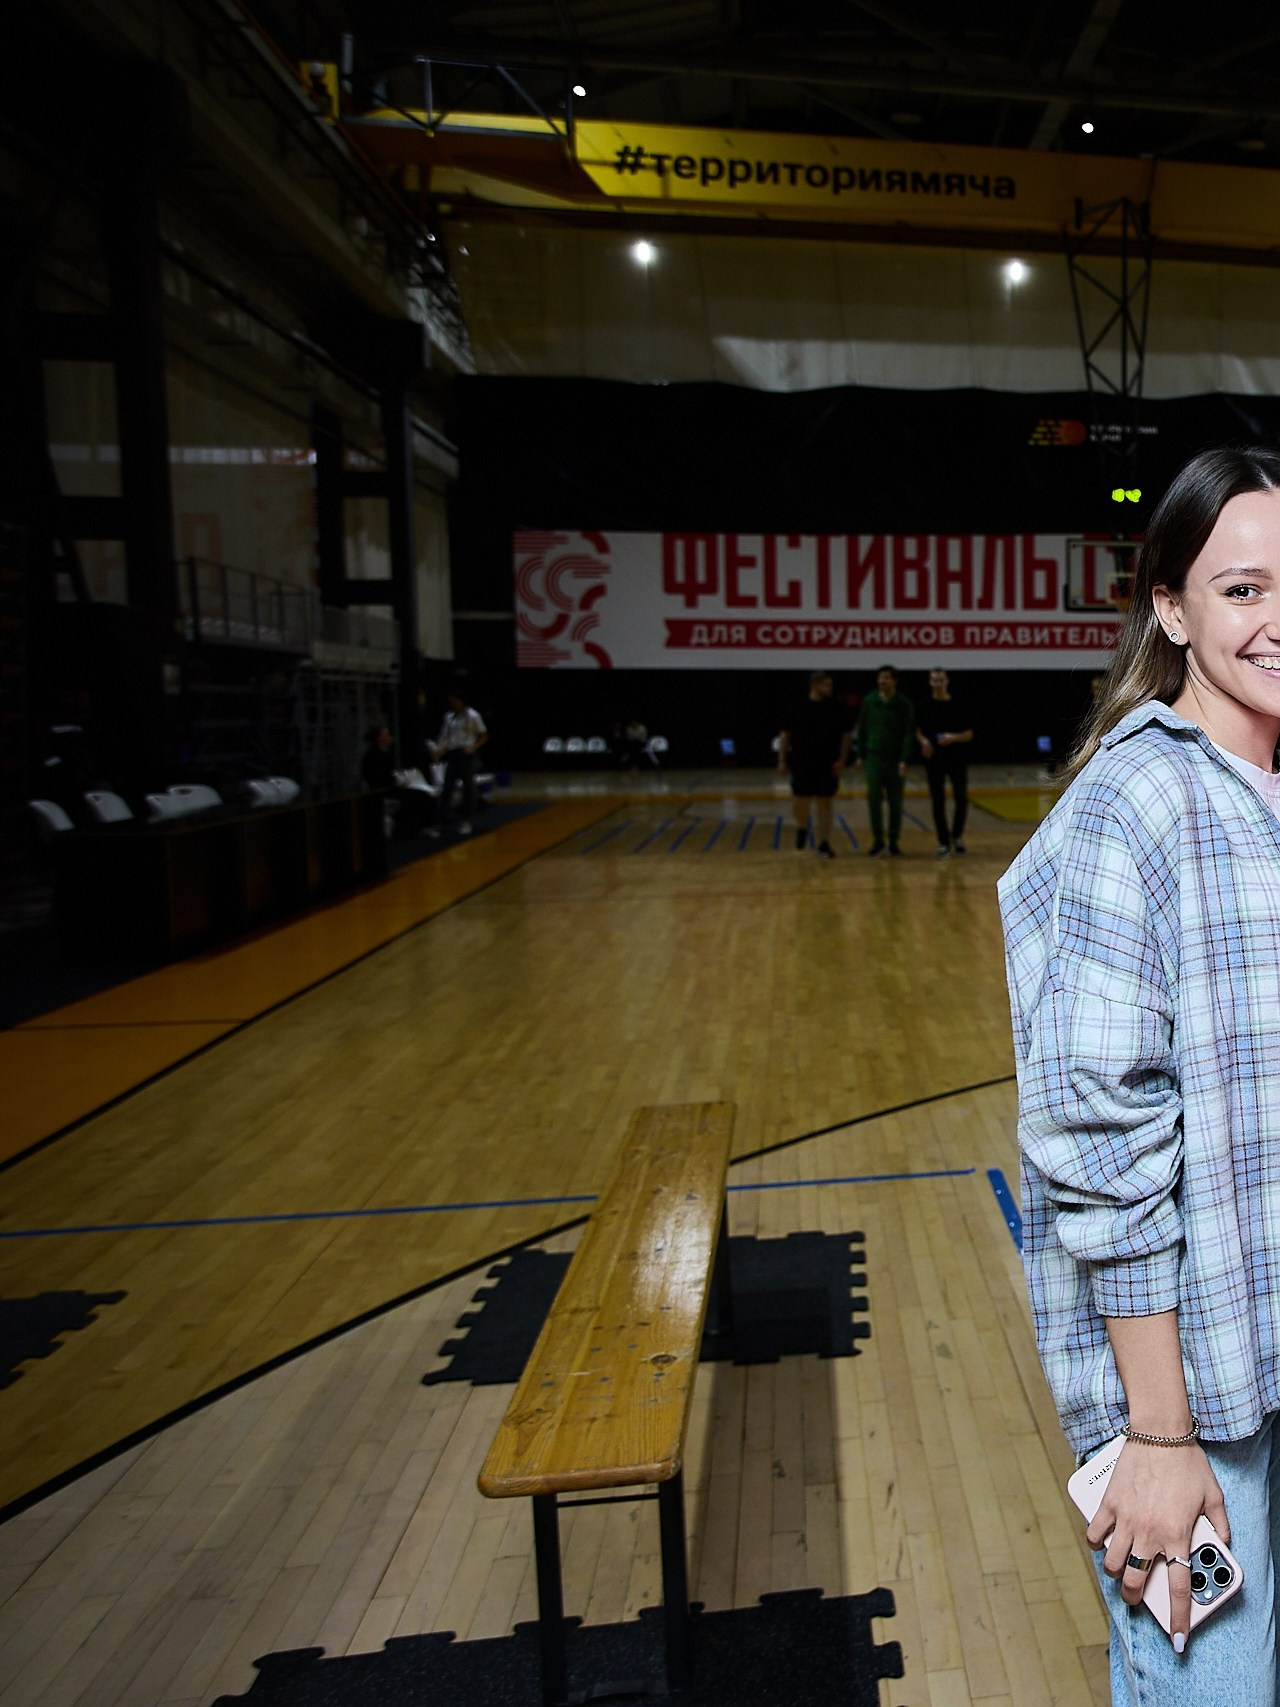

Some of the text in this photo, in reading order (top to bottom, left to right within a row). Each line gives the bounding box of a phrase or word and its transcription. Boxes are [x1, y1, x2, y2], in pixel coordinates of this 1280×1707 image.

[614, 145, 1018, 199] #территориямяча
[663, 531, 1057, 609] ФЕСТИВАЛЬ
[691, 624, 747, 648] ДЛЯ
[755, 624, 956, 649] СОТРУДНИКОВ
